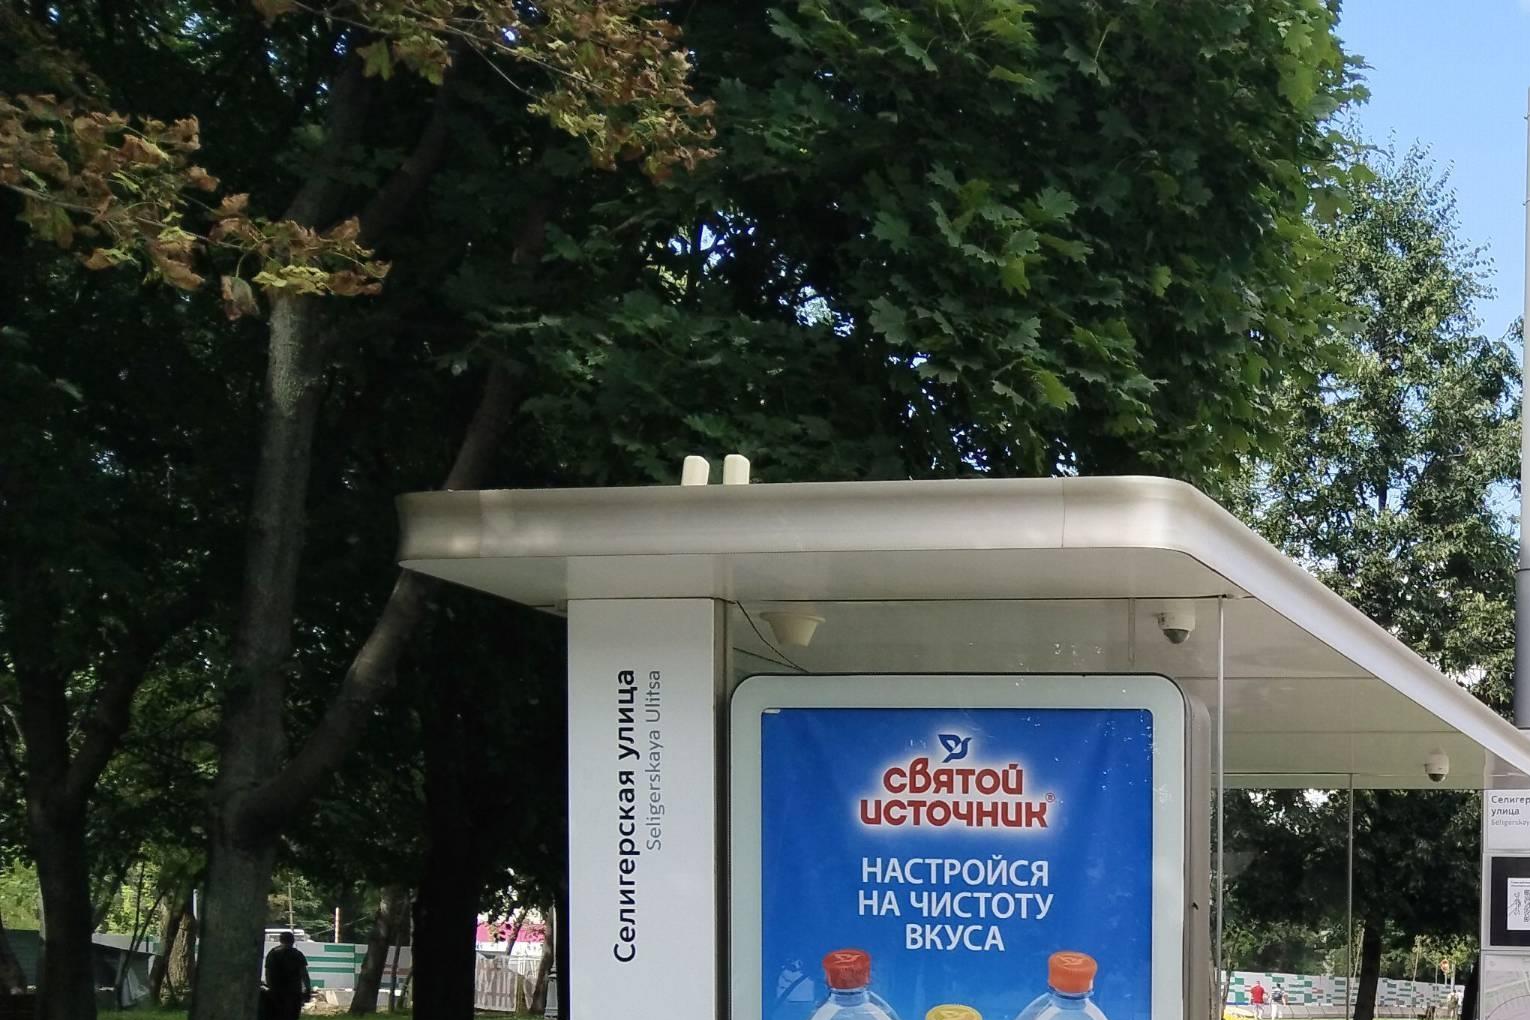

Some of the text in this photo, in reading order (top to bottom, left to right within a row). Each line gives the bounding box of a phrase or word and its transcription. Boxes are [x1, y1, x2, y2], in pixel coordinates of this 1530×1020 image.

[645, 670, 665, 851] Seligerskaya Ulitsa
[612, 669, 641, 963] Селигерская улица
[1491, 808, 1520, 816] улица
[861, 854, 1050, 887] НАСТРОЙСЯ
[858, 890, 1055, 920] НА ЧИСТОТУ
[905, 923, 1005, 952] ВКУСА
